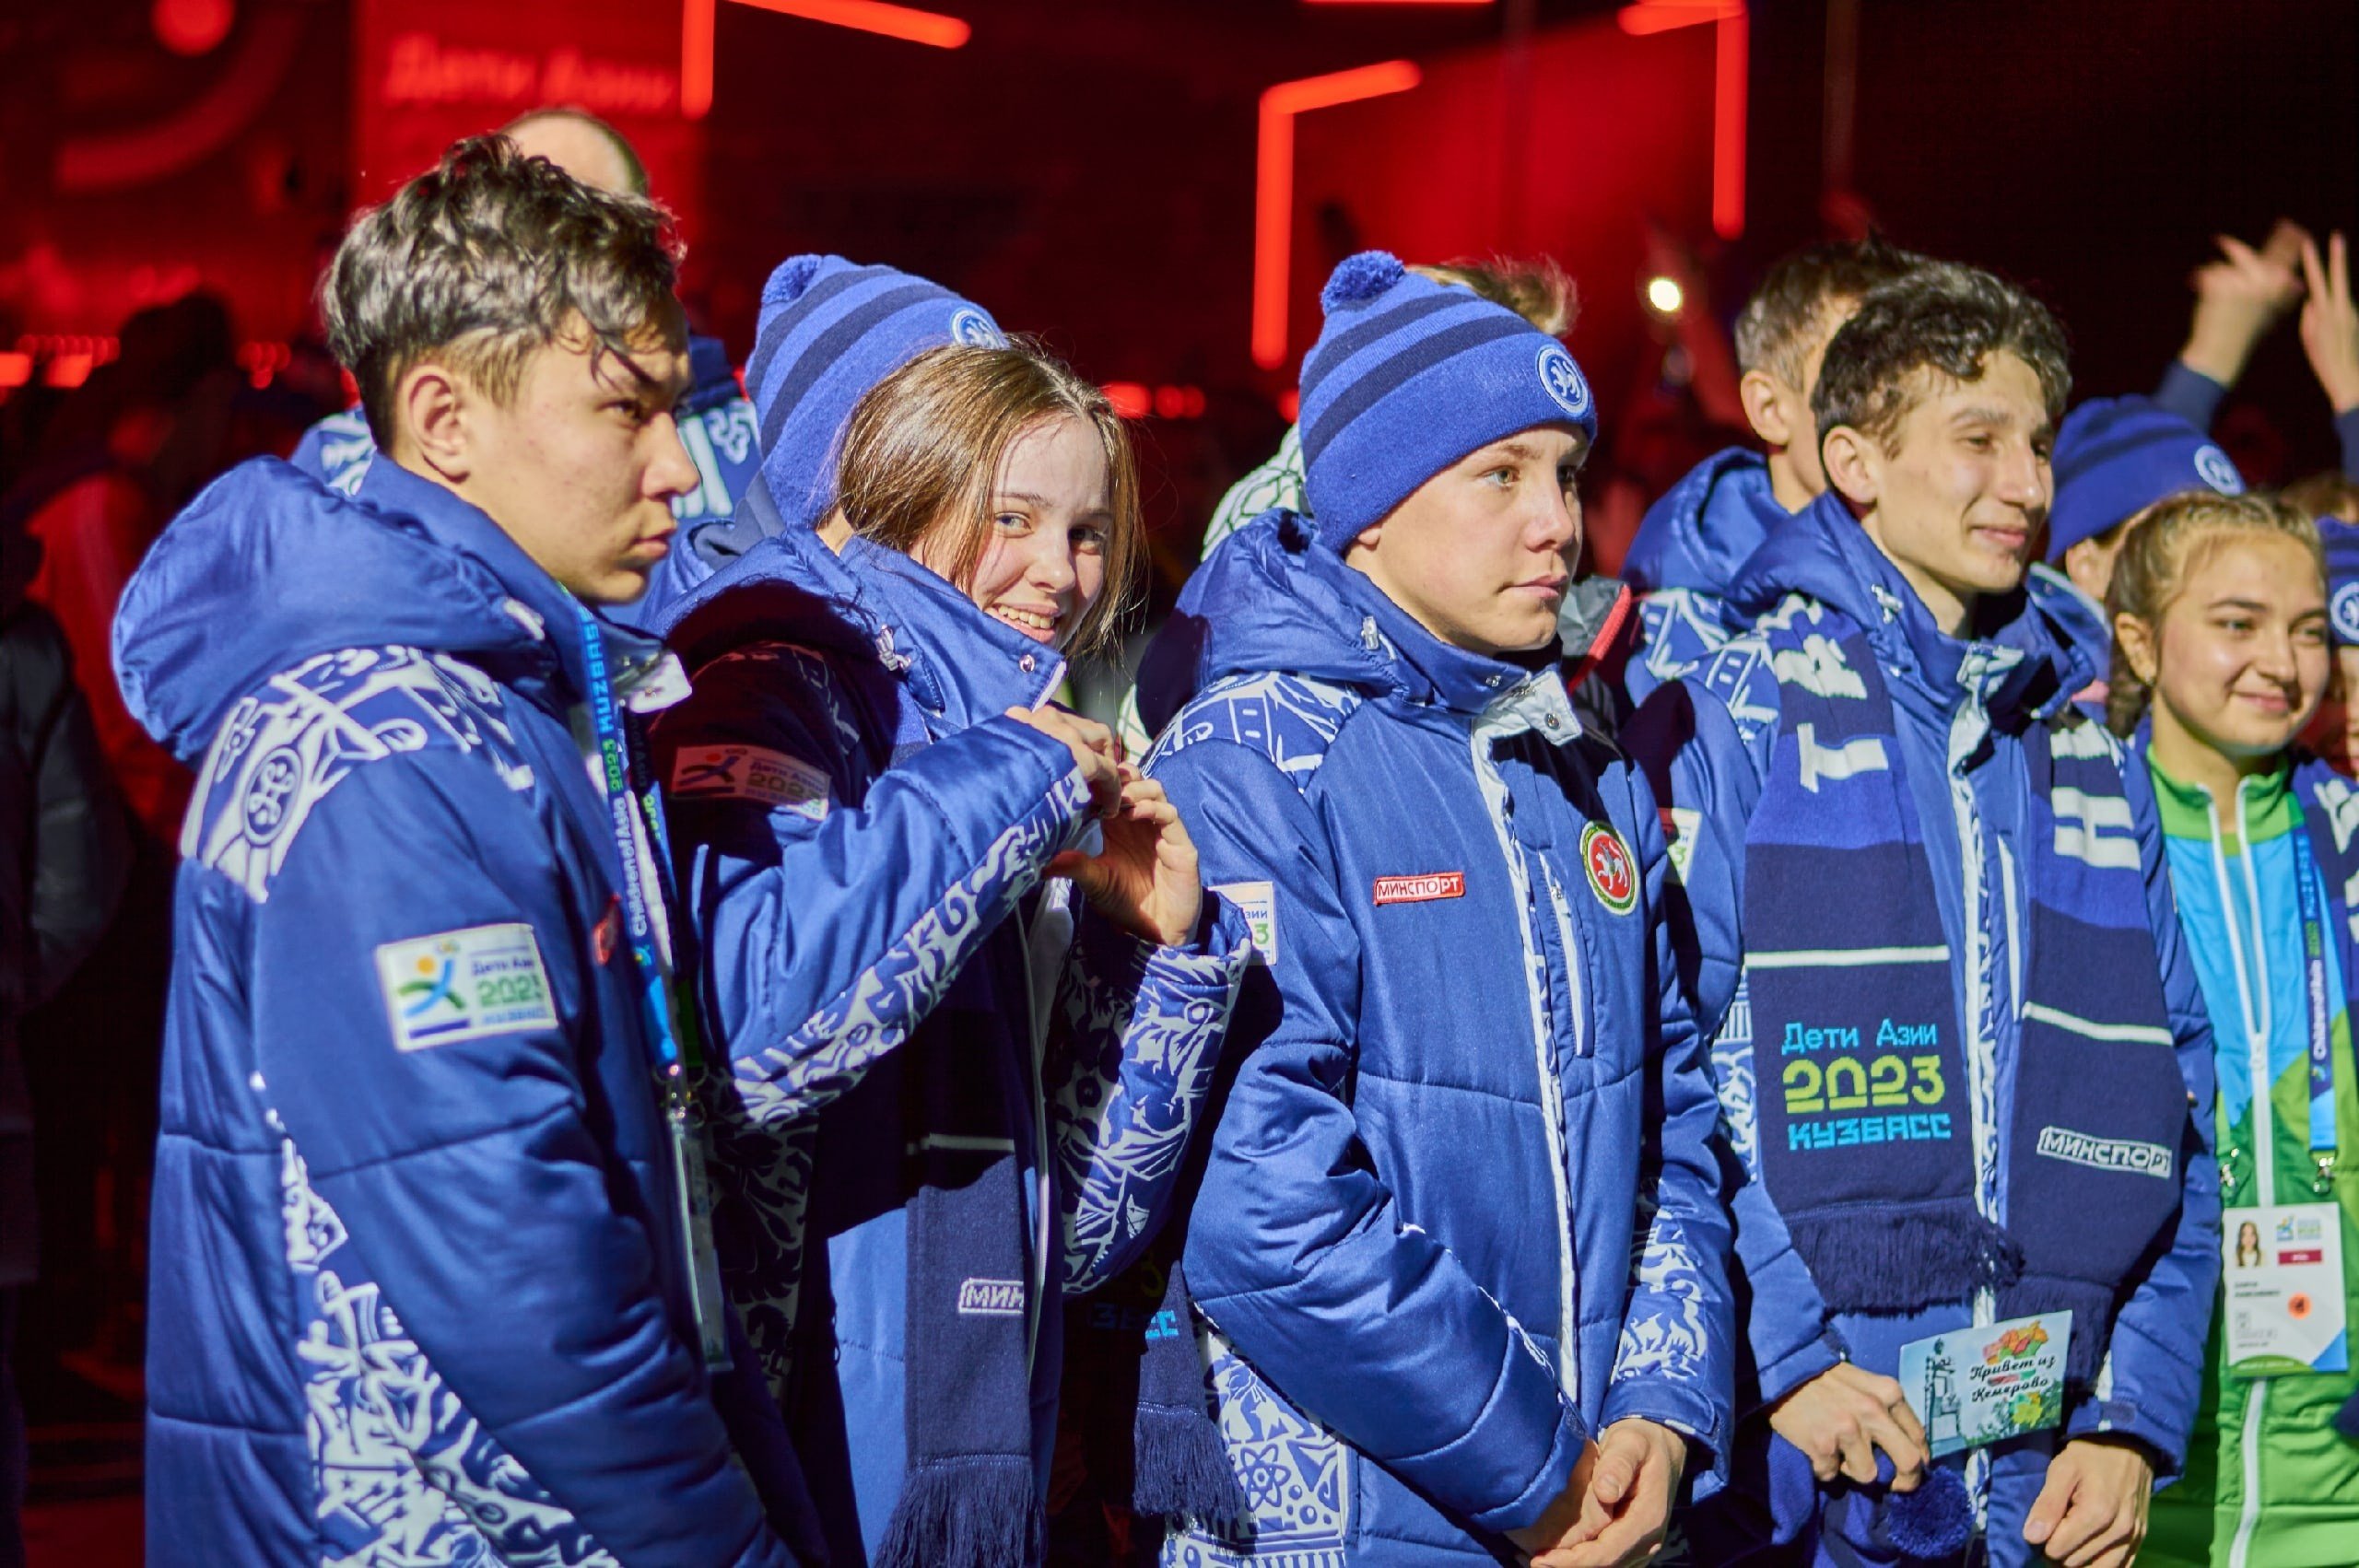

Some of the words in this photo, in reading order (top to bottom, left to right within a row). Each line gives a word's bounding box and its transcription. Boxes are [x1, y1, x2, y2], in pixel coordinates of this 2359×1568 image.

[602, 739, 624, 792] 2023
[613, 797, 632, 838] Asia
[623, 858, 648, 937] Children
[1378, 876, 1460, 898] МИНСПОРТ
[1781, 1023, 1860, 1057] Дети
[1875, 1017, 1938, 1048] Азии
[1782, 1054, 1946, 1114] 2023
[1788, 1113, 1953, 1151] КУЗБАСС
[966, 1285, 1024, 1308] МИН
[1970, 1360, 2034, 1382] Привет
[2037, 1355, 2056, 1369] из
[1971, 1376, 2048, 1402] Кемерово
